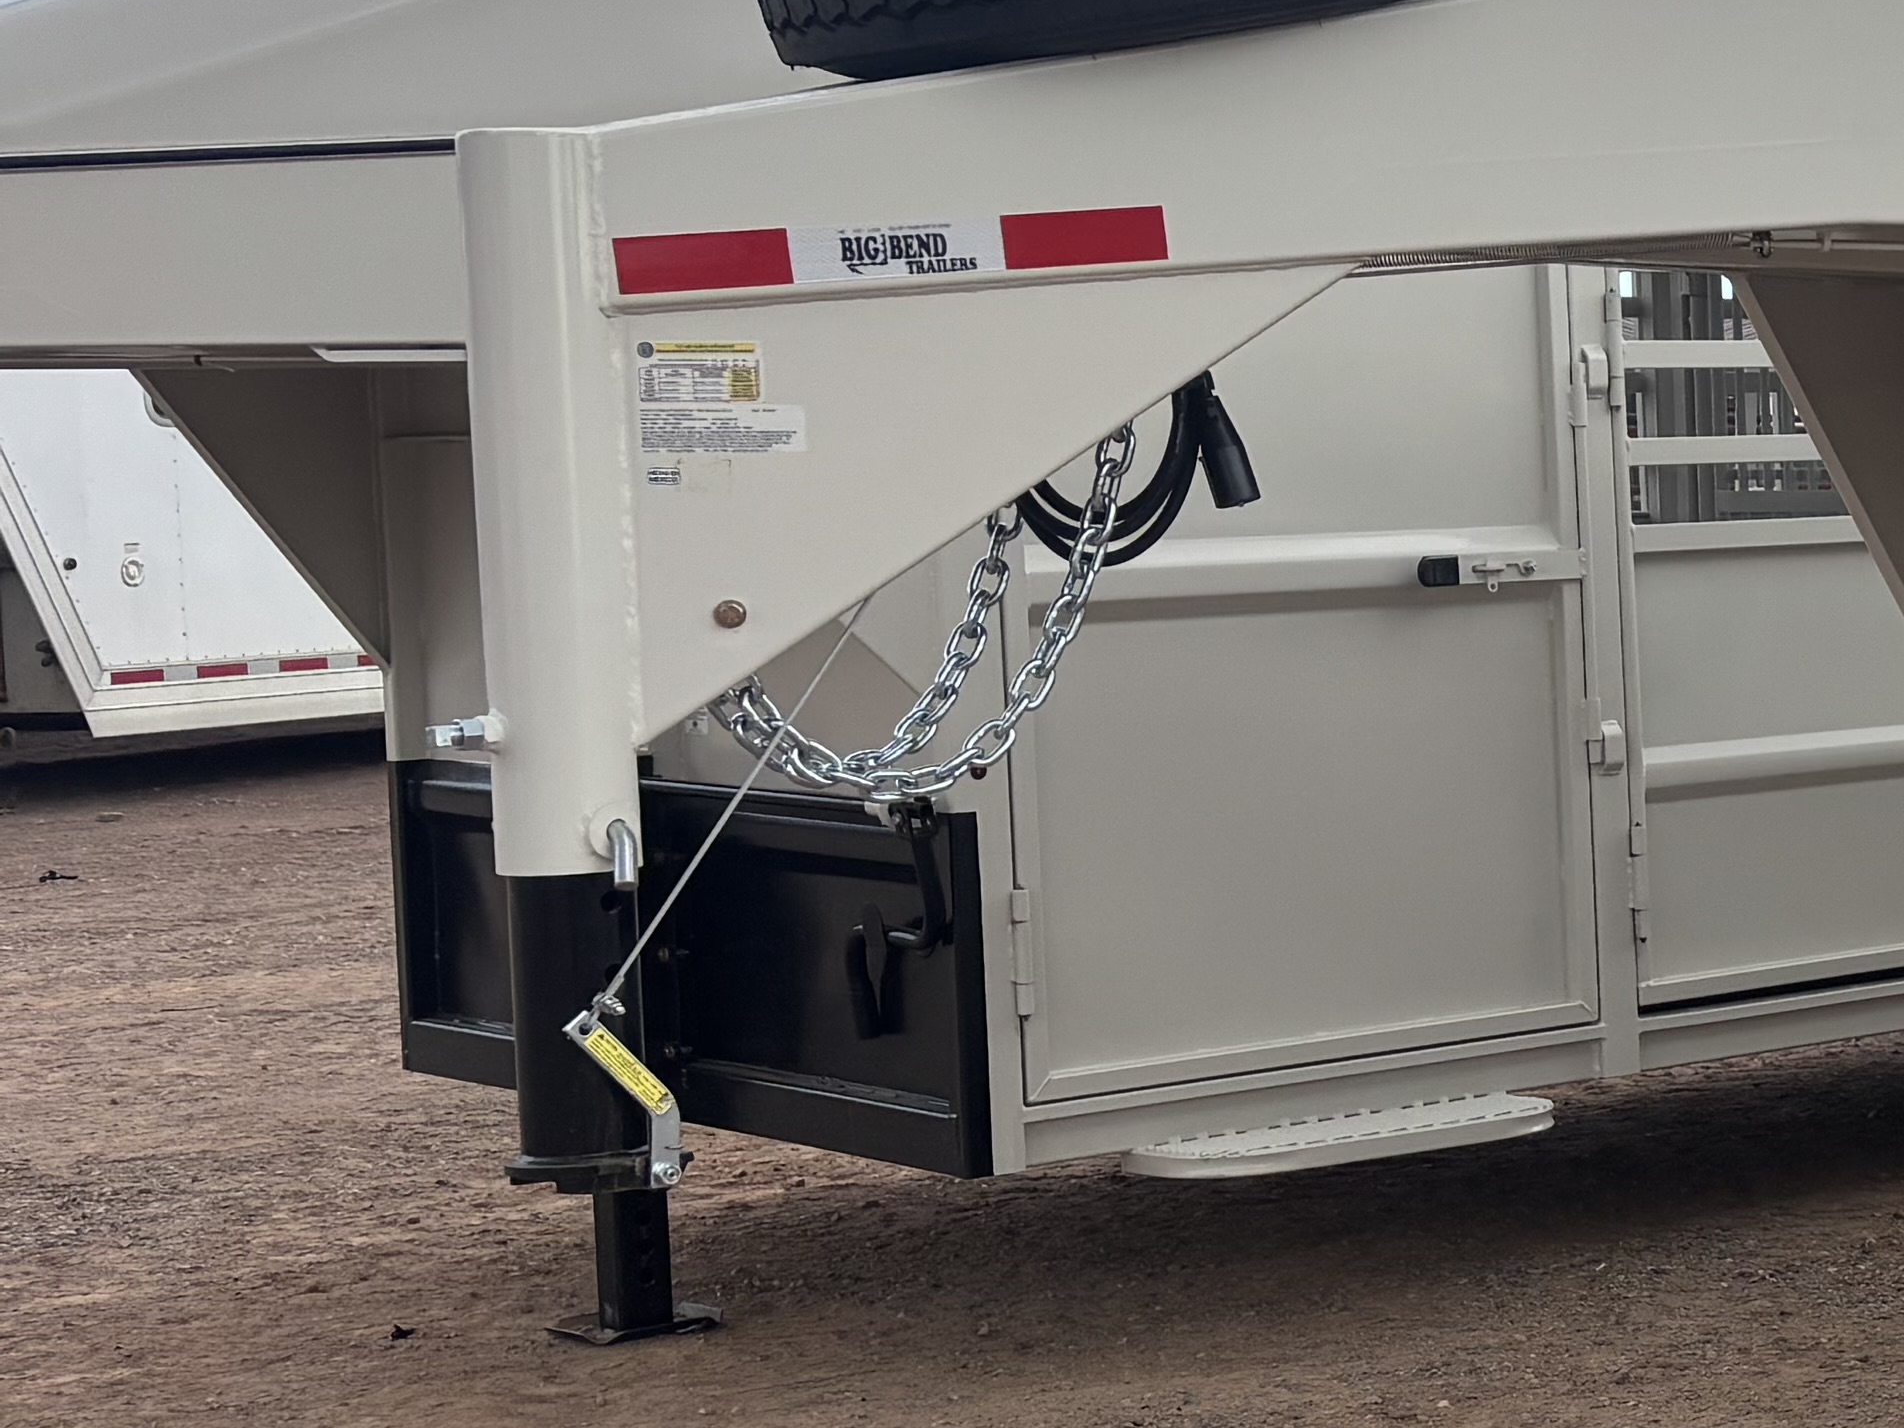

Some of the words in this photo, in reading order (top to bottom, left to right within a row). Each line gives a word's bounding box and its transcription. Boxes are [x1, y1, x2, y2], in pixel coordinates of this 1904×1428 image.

[839, 235, 880, 262] BIG
[888, 233, 948, 260] BEND
[905, 257, 978, 274] TRAILERS
